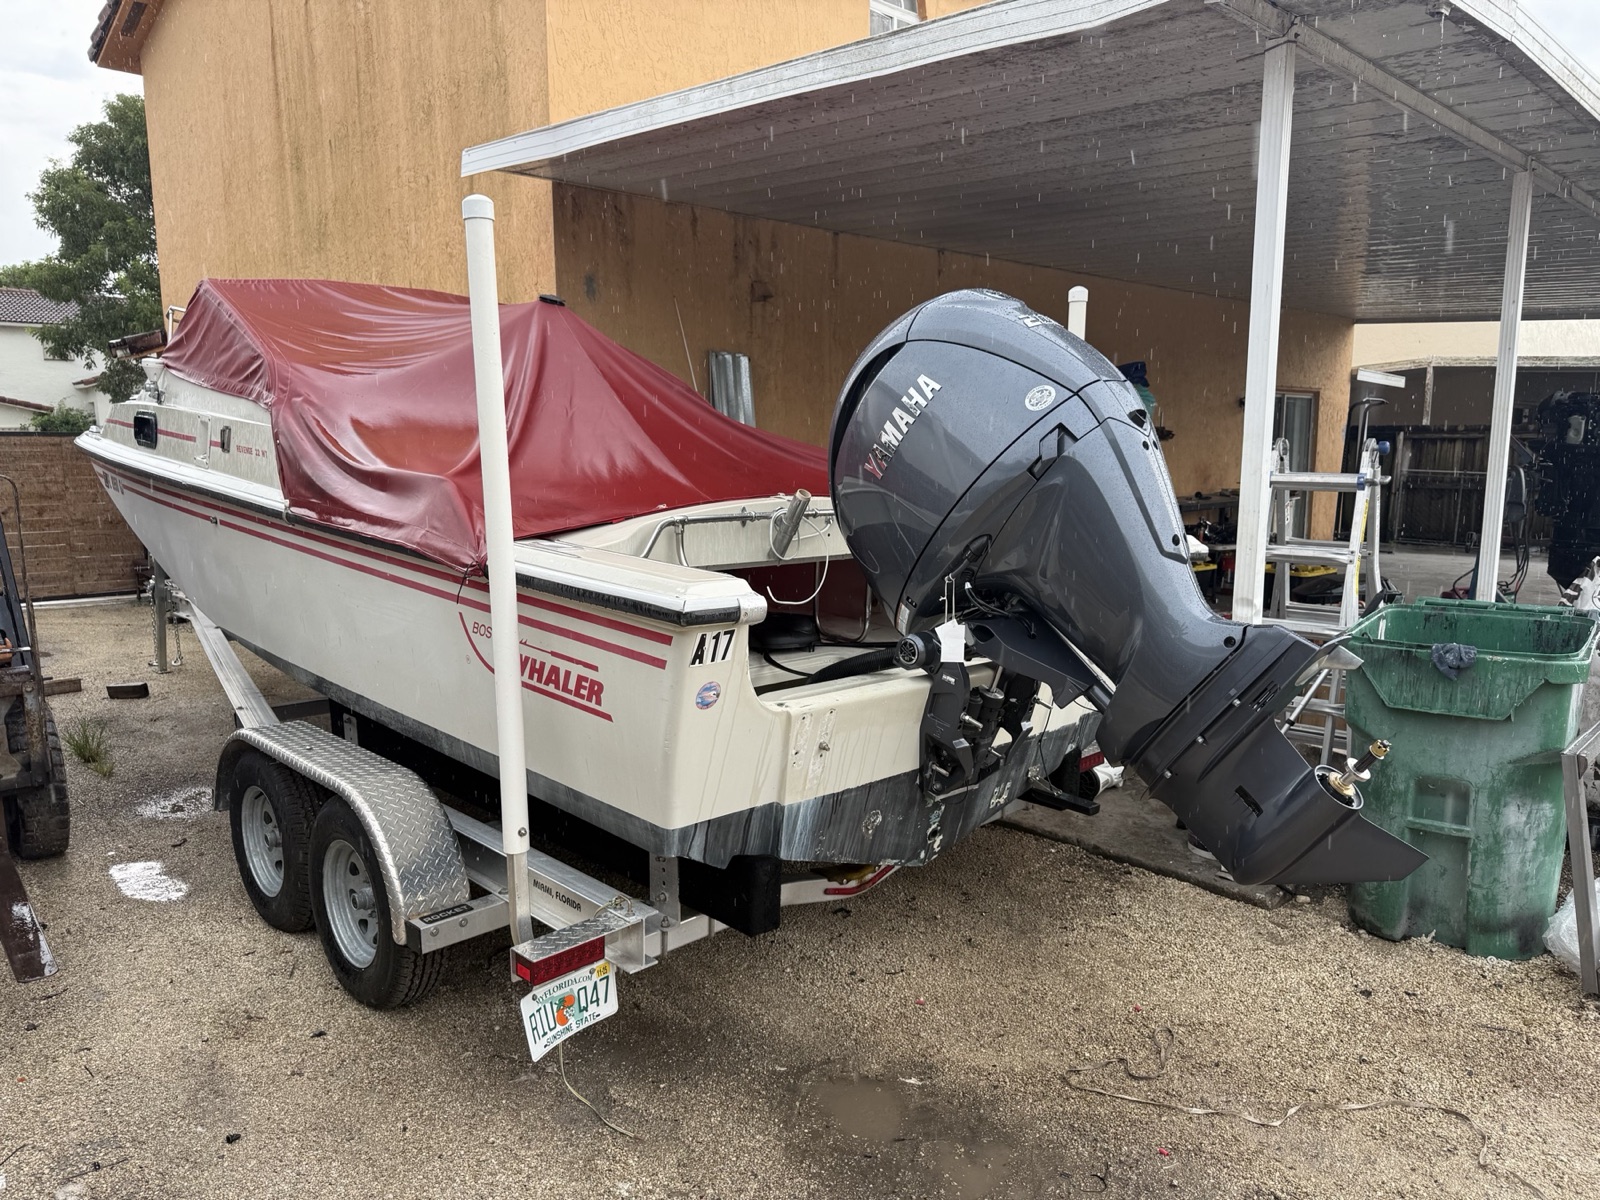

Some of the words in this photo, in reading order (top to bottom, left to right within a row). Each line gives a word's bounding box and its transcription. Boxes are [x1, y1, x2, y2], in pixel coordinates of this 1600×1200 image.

[864, 373, 942, 480] YAMAHA
[472, 621, 493, 639] BOS
[690, 628, 736, 666] A17
[423, 903, 470, 924] ROCKET
[533, 878, 555, 899] MIAMI,
[555, 890, 582, 913] FLORIDA
[529, 1001, 557, 1044] RIU
[577, 975, 610, 1013] Q47
[546, 1022, 573, 1047] SUNSHINE
[575, 1011, 597, 1029] STATE
